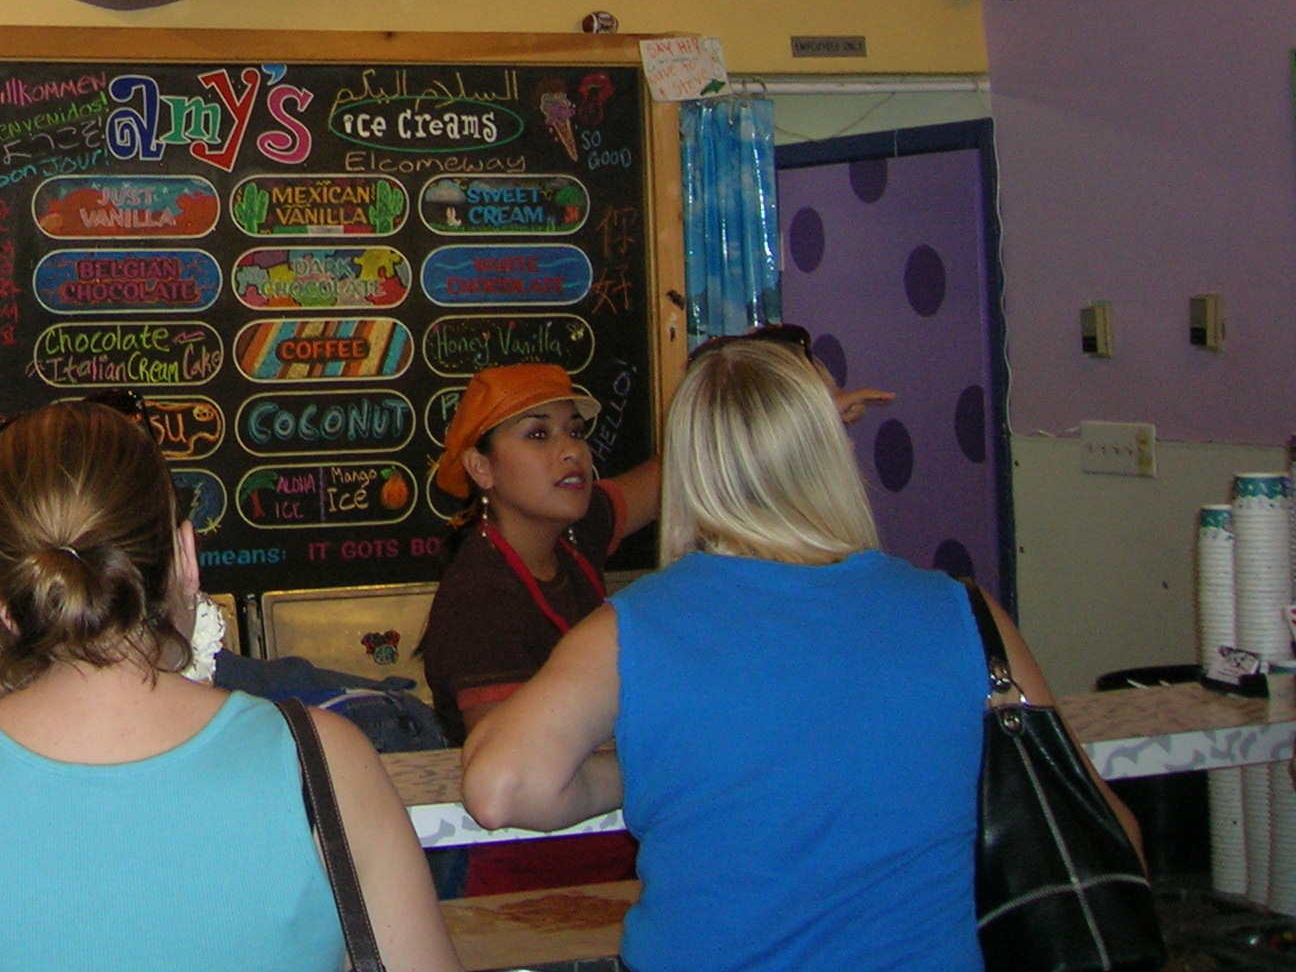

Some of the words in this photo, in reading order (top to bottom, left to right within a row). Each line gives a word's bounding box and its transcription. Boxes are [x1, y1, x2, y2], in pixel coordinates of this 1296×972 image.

[106, 63, 314, 173] amy's
[397, 109, 498, 143] Creams
[588, 147, 632, 171] GOOD
[97, 186, 154, 207] JUST
[272, 186, 370, 205] MEXICAN
[466, 185, 542, 205] SWEET
[78, 207, 177, 228] VANILLA
[274, 207, 369, 226] VANILLA
[467, 205, 544, 226] CREAM
[77, 258, 181, 280] BELGIAN
[292, 256, 356, 278] DARK
[472, 255, 541, 273] WHITE
[60, 279, 199, 303] CHOCOLATE
[260, 277, 388, 300] CHOCOLATE
[446, 275, 566, 296] CHOCOLATE
[45, 324, 170, 355] Chocolate
[280, 339, 367, 360] COFFEE
[435, 326, 490, 366] Honey
[497, 322, 563, 357] Vanilla
[46, 353, 127, 384] Italian
[182, 342, 222, 381] Cake
[248, 397, 410, 445] COCONUT
[276, 473, 316, 495] ALOHA
[330, 466, 378, 488] Mango
[275, 501, 305, 519] ICE
[307, 542, 331, 561] IT
[340, 538, 400, 560] GOTS
[409, 536, 442, 557] BO
